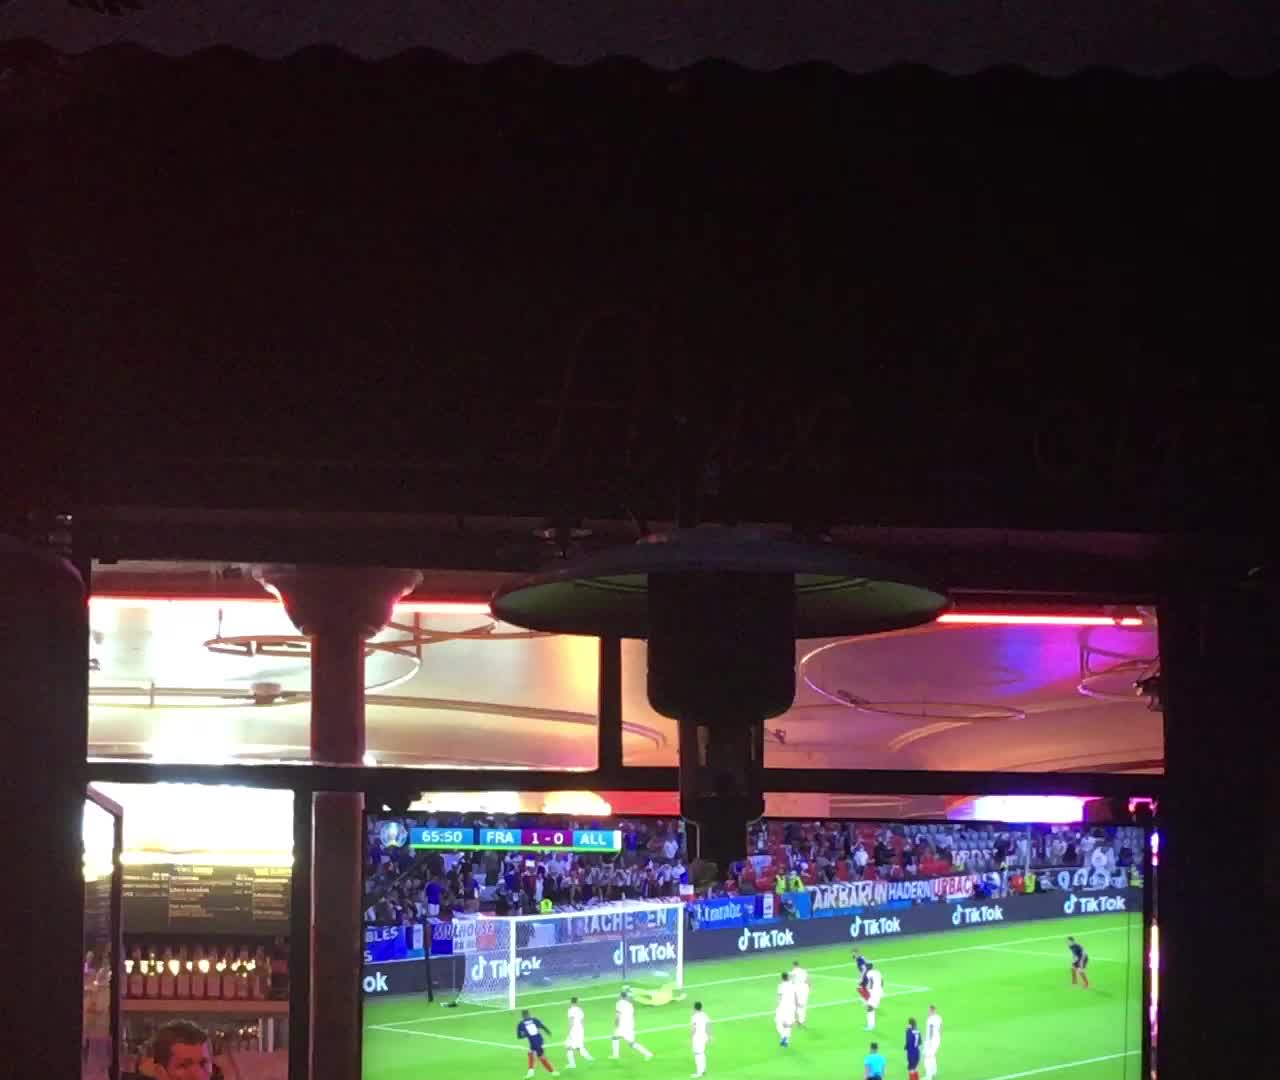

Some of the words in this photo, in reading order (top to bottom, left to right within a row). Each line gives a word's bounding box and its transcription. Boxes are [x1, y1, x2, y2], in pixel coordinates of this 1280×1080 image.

[422, 831, 463, 843] 65:50
[486, 833, 514, 844] FRA
[579, 834, 607, 845] ALL
[1080, 895, 1126, 912] TikTok
[965, 905, 1003, 923] TikTok
[863, 916, 901, 936] TikTok
[752, 928, 794, 949] TikTok
[629, 941, 676, 964] TikTok
